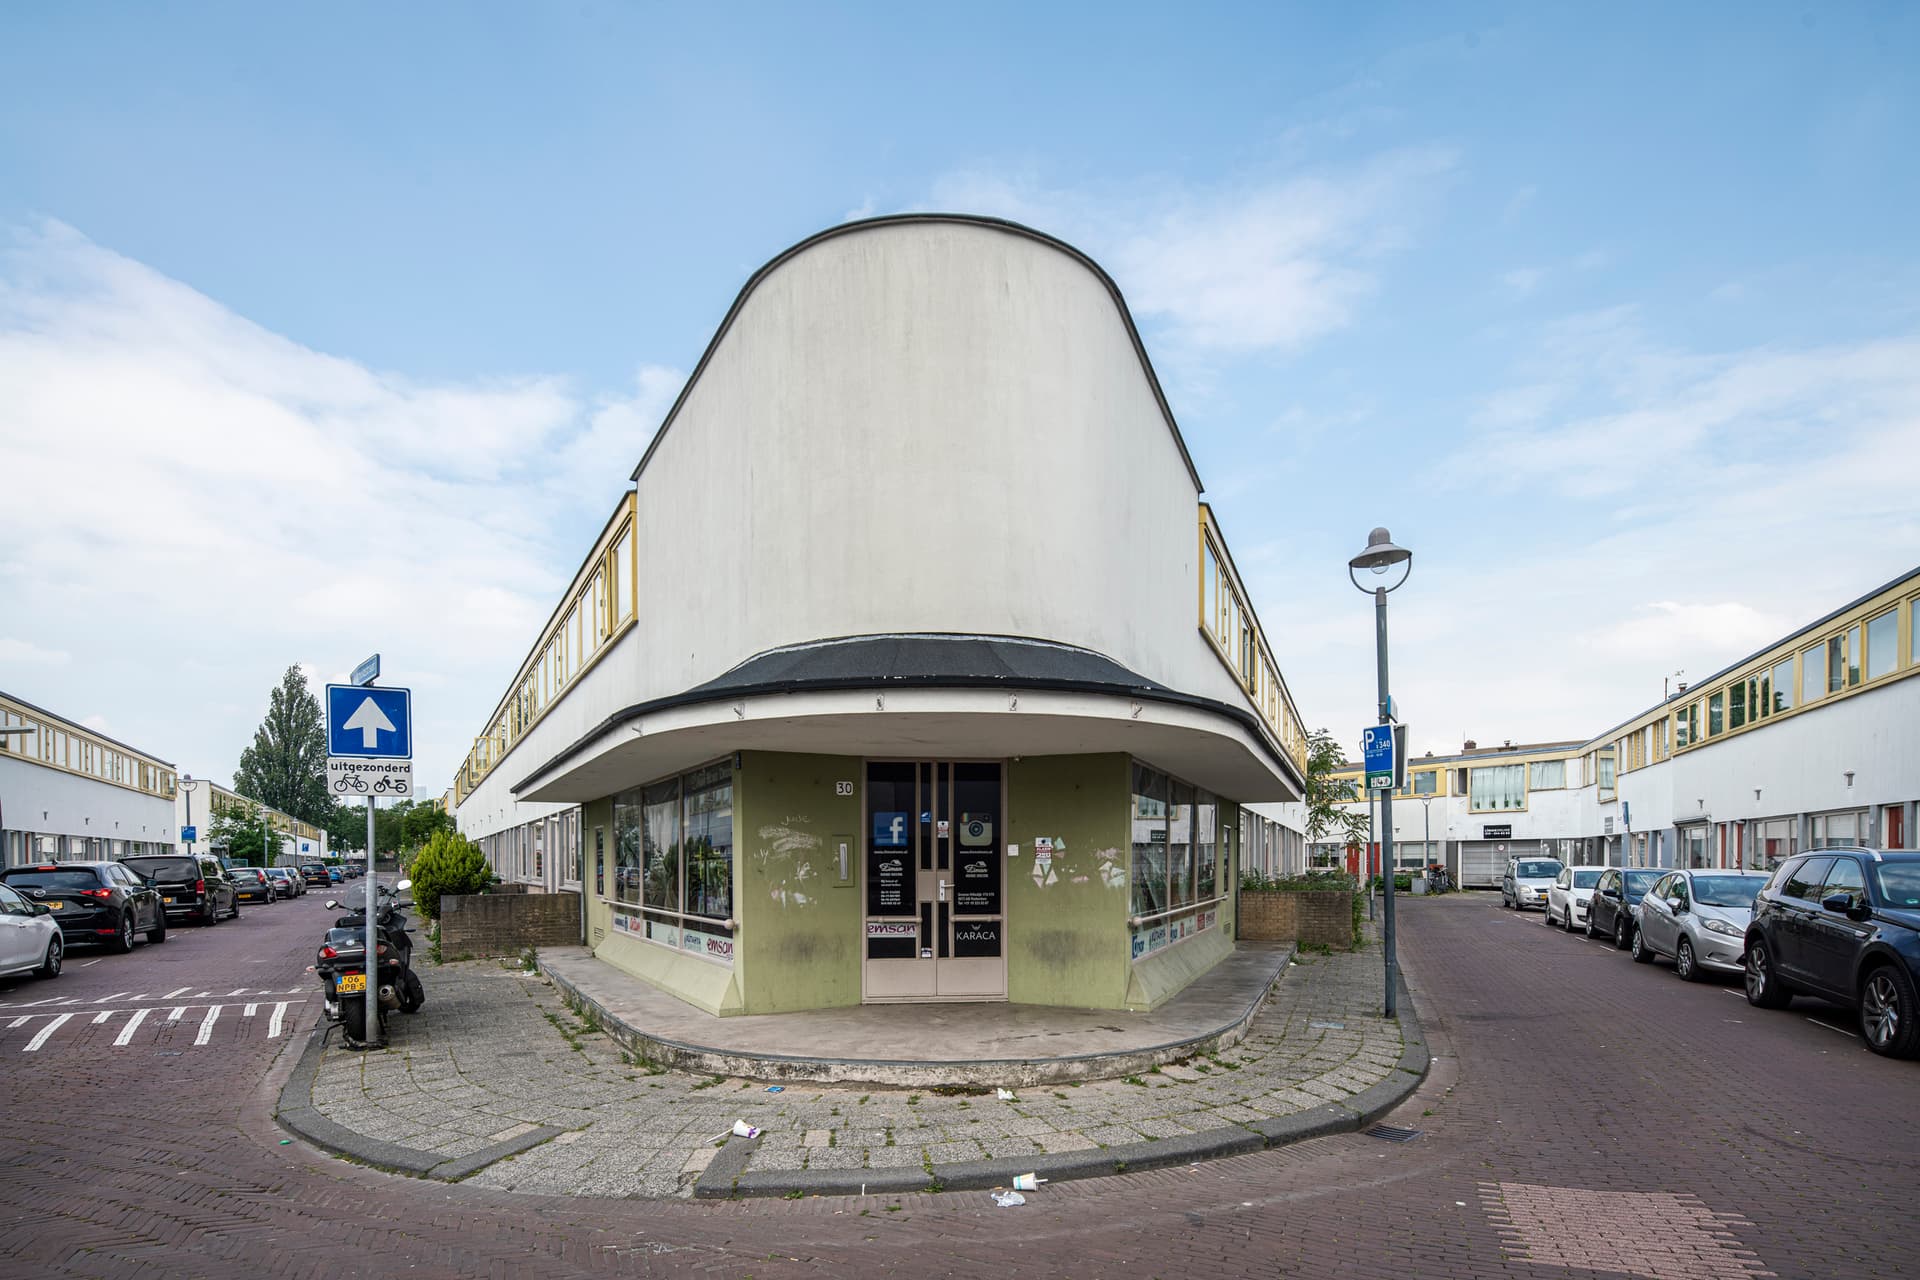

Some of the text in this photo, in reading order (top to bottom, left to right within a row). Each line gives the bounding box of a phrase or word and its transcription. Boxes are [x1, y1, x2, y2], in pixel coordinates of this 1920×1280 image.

[1365, 730, 1375, 750] P
[331, 762, 411, 774] uitgezonderd
[837, 782, 853, 794] 30
[867, 923, 916, 934] emsan
[956, 931, 996, 941] KARACA
